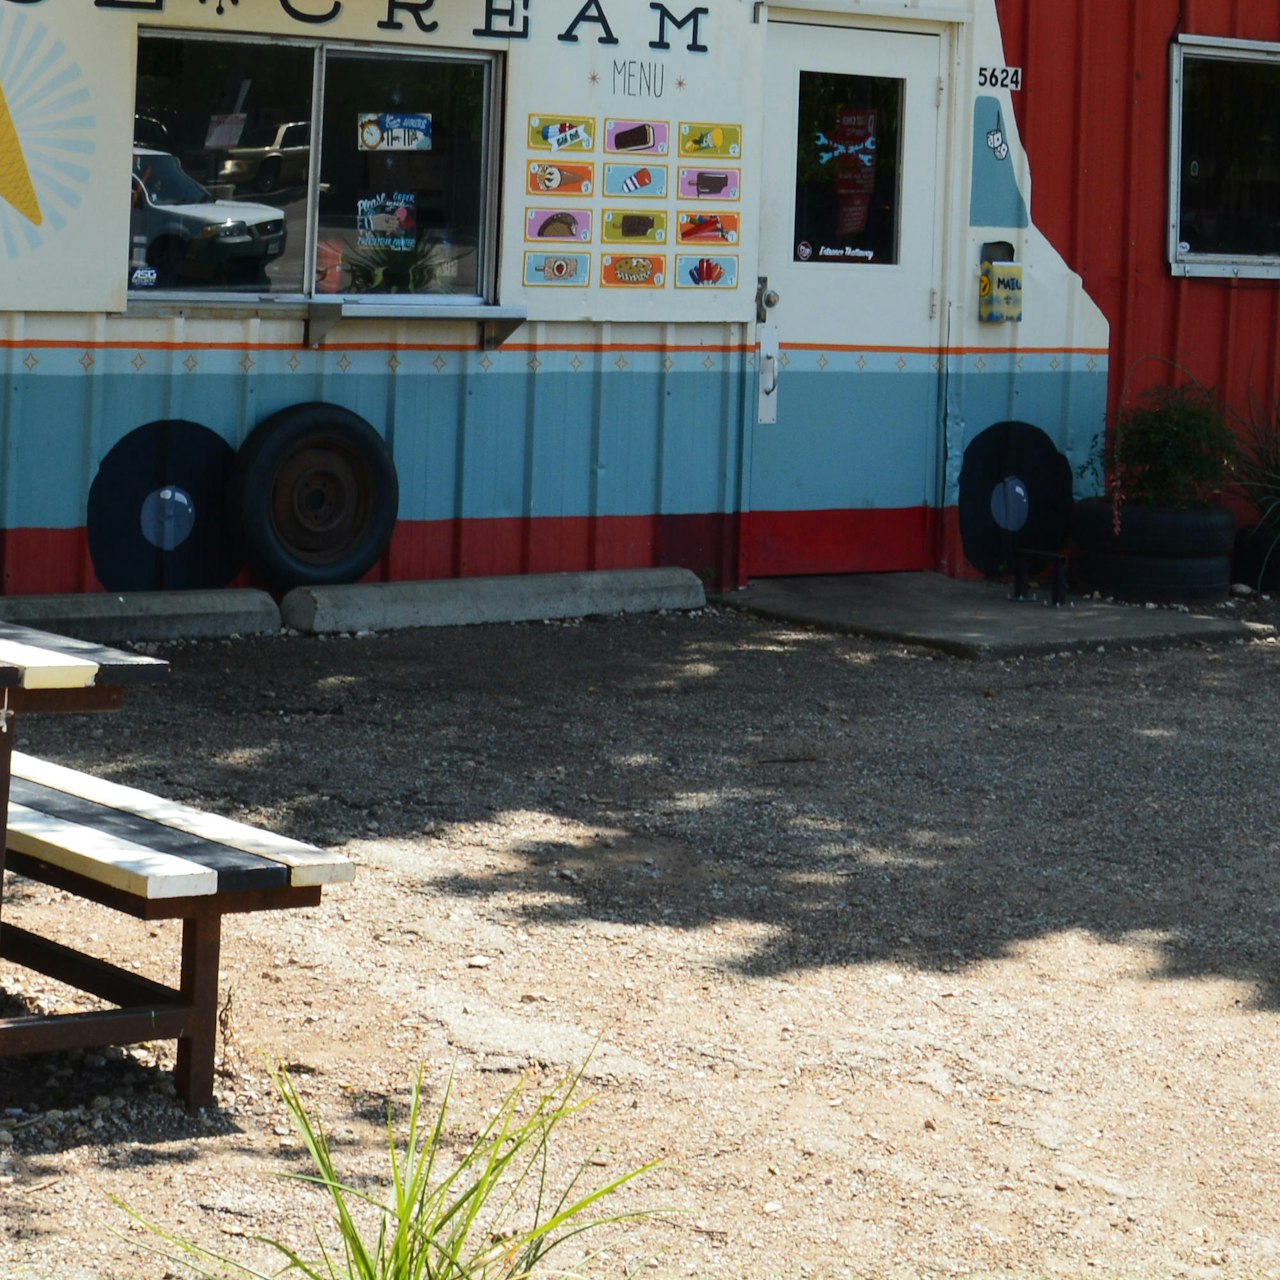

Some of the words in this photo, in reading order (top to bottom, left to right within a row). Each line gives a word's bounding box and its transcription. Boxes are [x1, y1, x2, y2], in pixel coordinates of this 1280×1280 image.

[612, 59, 665, 98] MENU
[978, 66, 1020, 89] 5624
[997, 276, 1022, 290] MAIL
